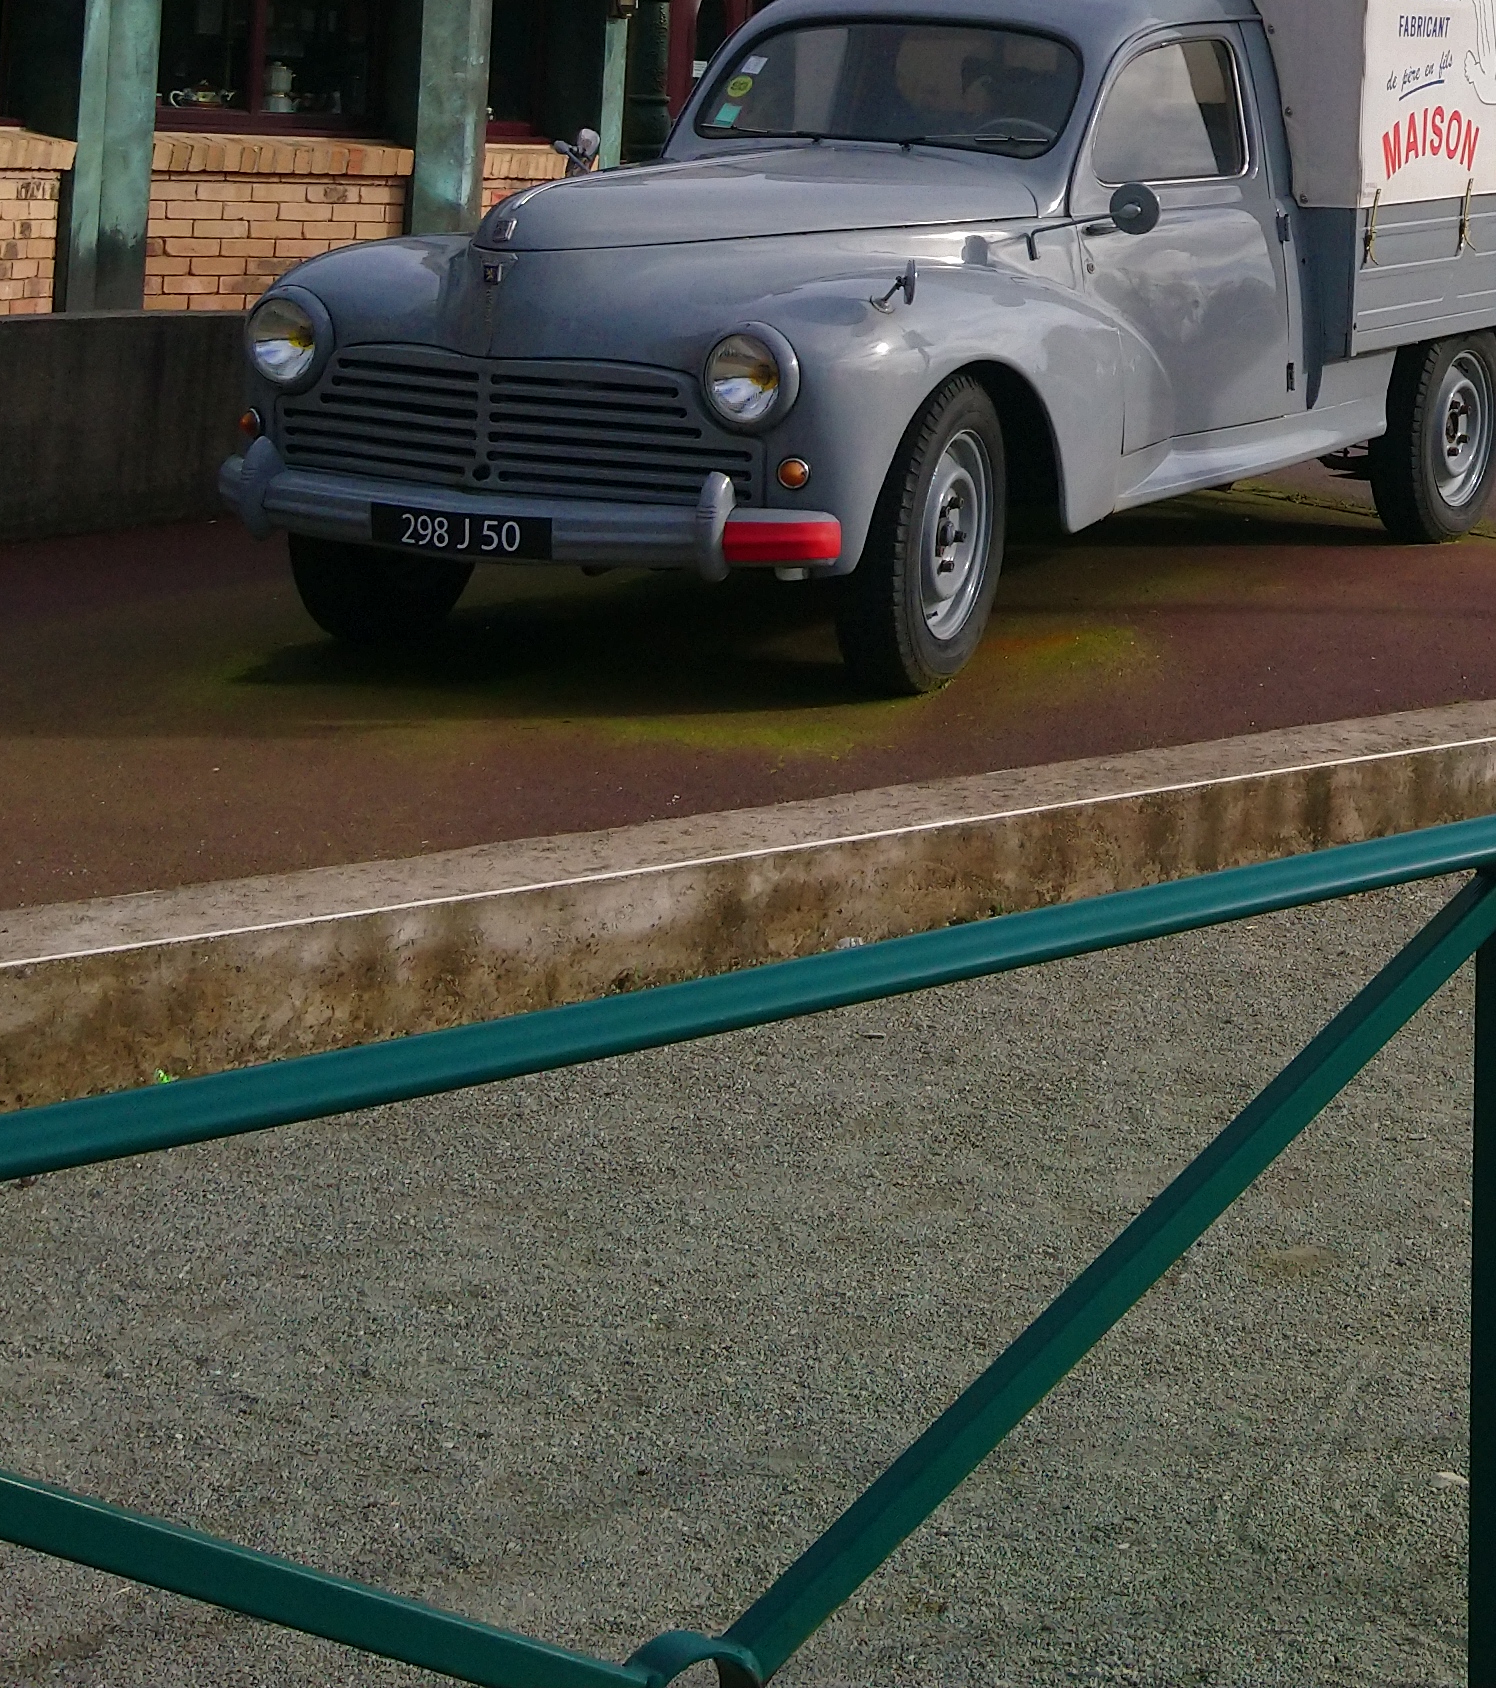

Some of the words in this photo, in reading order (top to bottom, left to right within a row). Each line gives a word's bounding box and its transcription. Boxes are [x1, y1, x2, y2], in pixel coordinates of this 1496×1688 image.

[1398, 15, 1451, 38] FABRICANT
[1386, 70, 1398, 91] de
[1424, 62, 1435, 77] en
[1438, 49, 1453, 79] fils
[1381, 105, 1480, 180] MAISON
[401, 513, 450, 548] 298
[456, 518, 471, 549] J
[481, 520, 521, 553] 50
